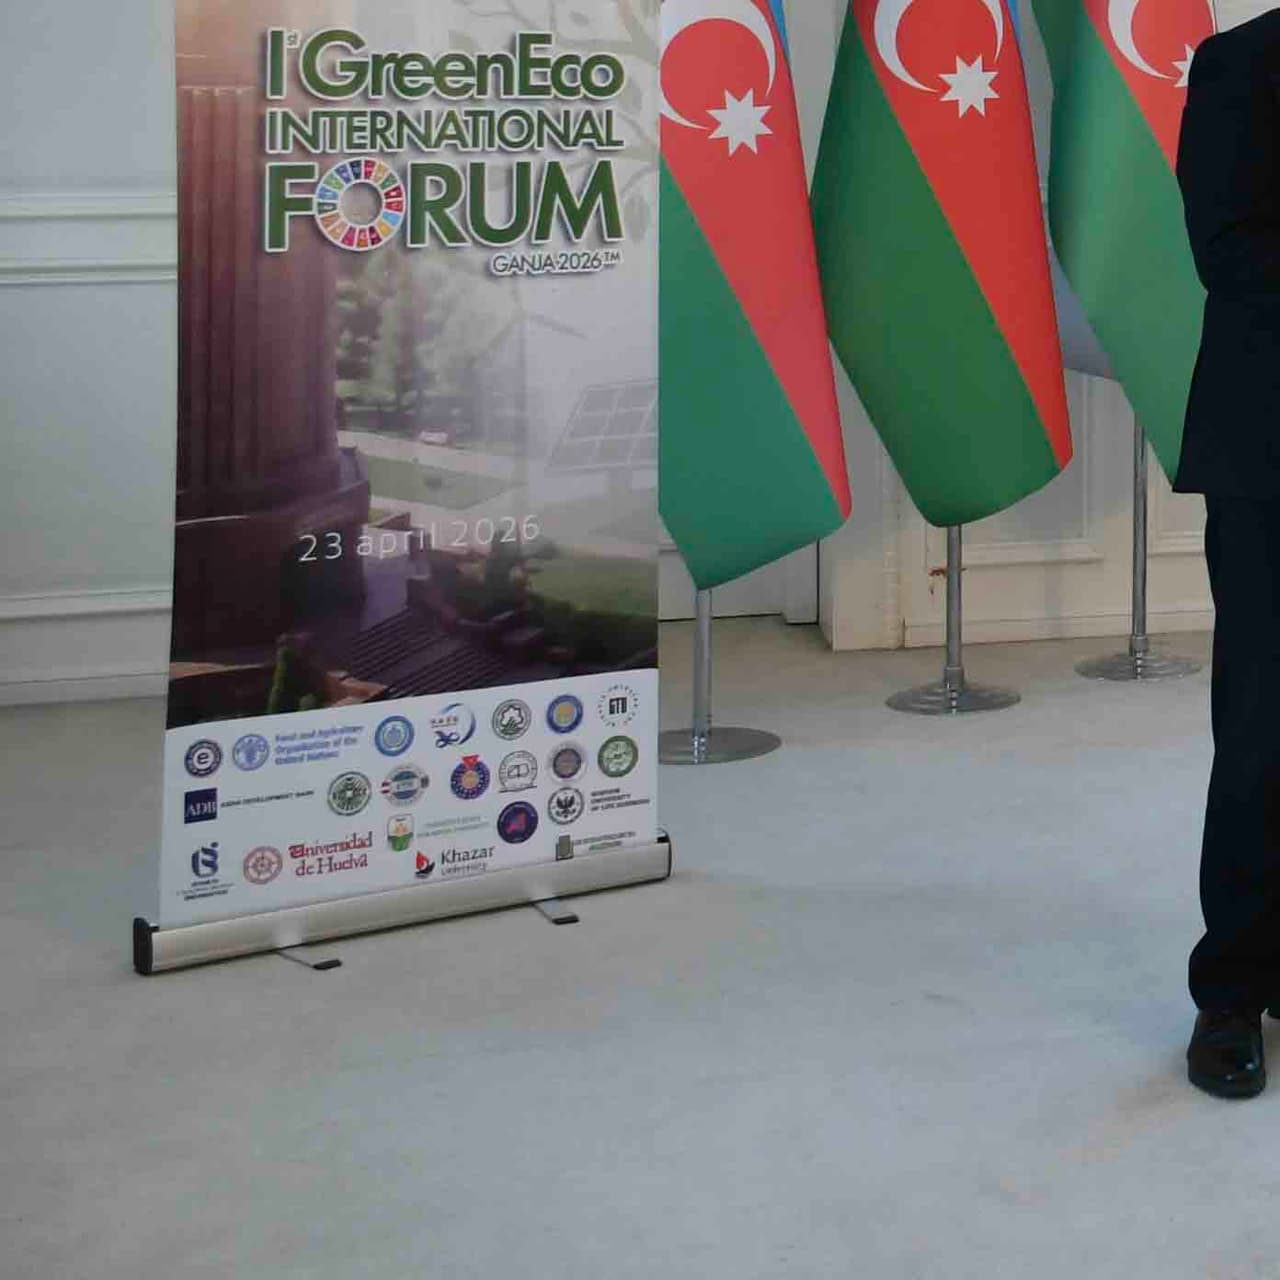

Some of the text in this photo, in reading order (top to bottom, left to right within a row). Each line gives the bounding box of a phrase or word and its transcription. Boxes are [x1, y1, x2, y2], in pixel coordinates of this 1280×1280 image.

[301, 29, 624, 99] GreenEco
[268, 109, 624, 151] INTERNATIONAL
[267, 158, 624, 250] FORUM
[298, 514, 540, 561] 23 april 2026
[288, 831, 373, 859] Universidad
[295, 853, 368, 876] de Huelva
[441, 845, 496, 865] Khazar
